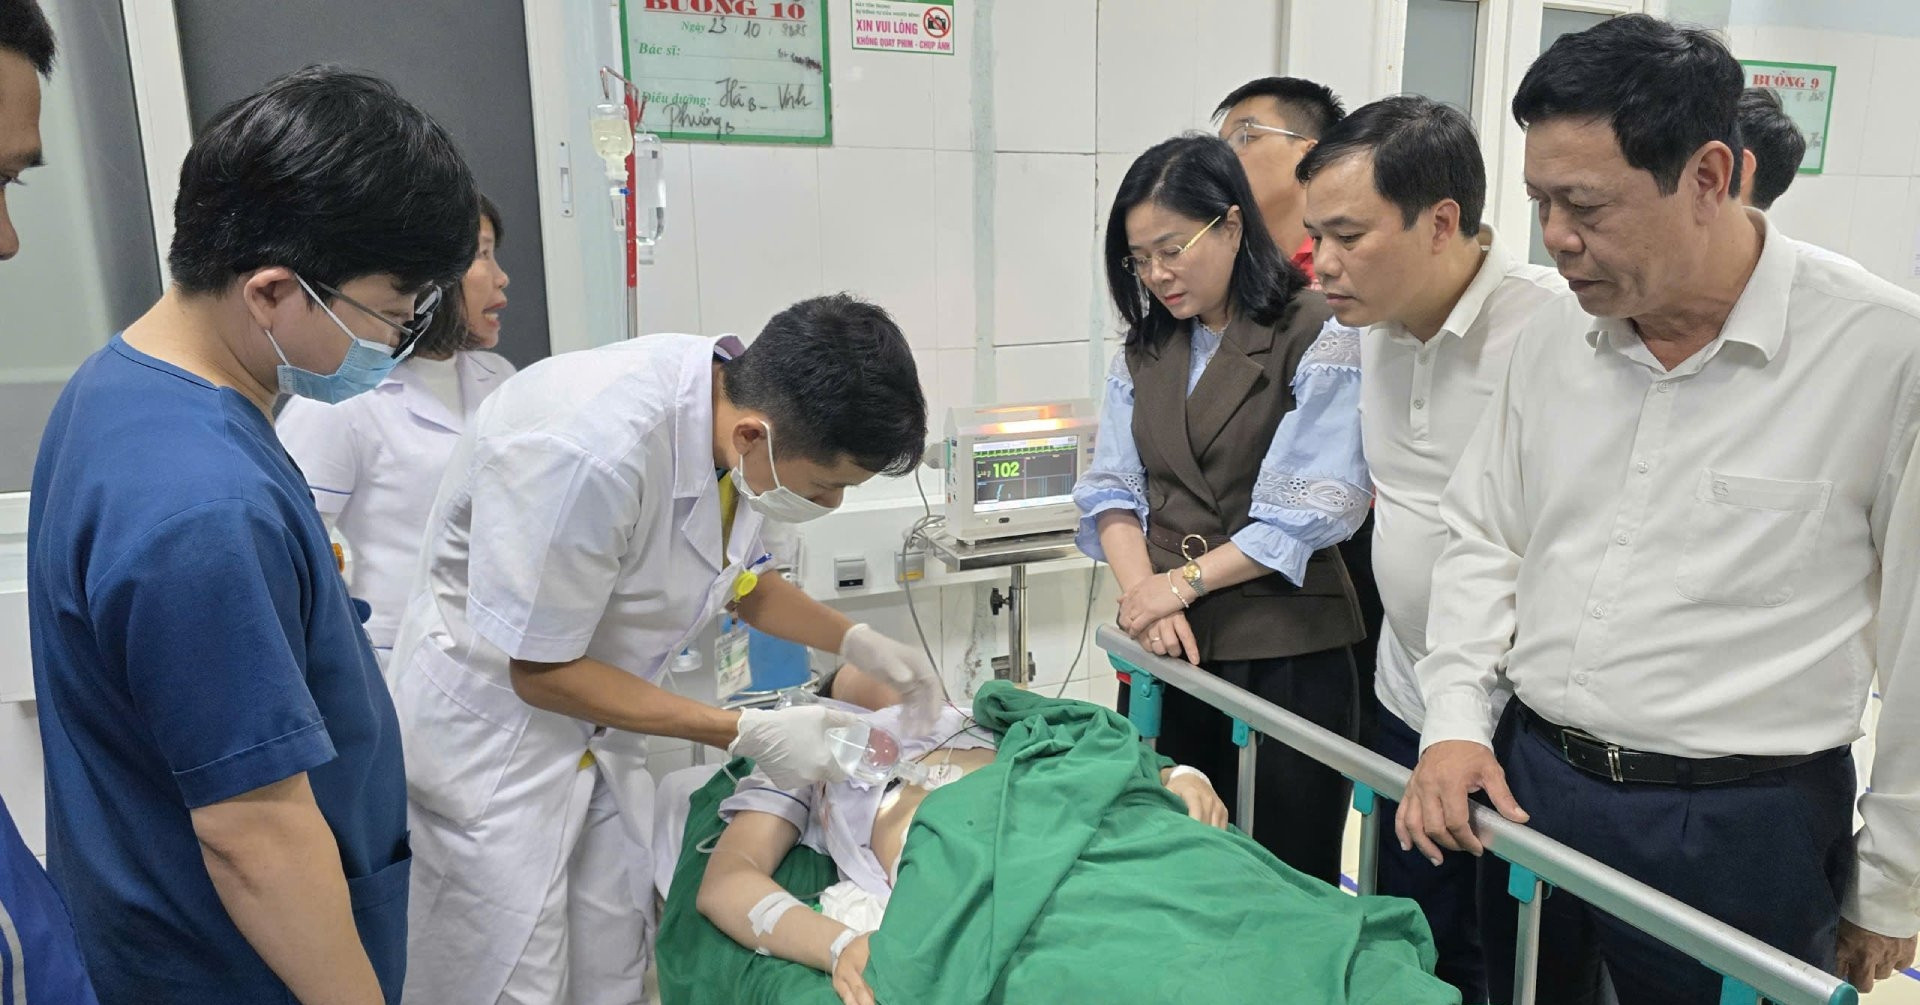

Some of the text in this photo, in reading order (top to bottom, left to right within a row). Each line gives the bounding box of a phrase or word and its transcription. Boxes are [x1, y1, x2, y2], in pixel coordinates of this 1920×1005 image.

[772, 3, 805, 19] 10
[743, 20, 761, 38] 10
[856, 19, 873, 32] XIN
[876, 21, 891, 33] VUI
[897, 39, 914, 48] PHIM
[1810, 78, 1820, 89] 9
[993, 462, 1019, 477] 102
